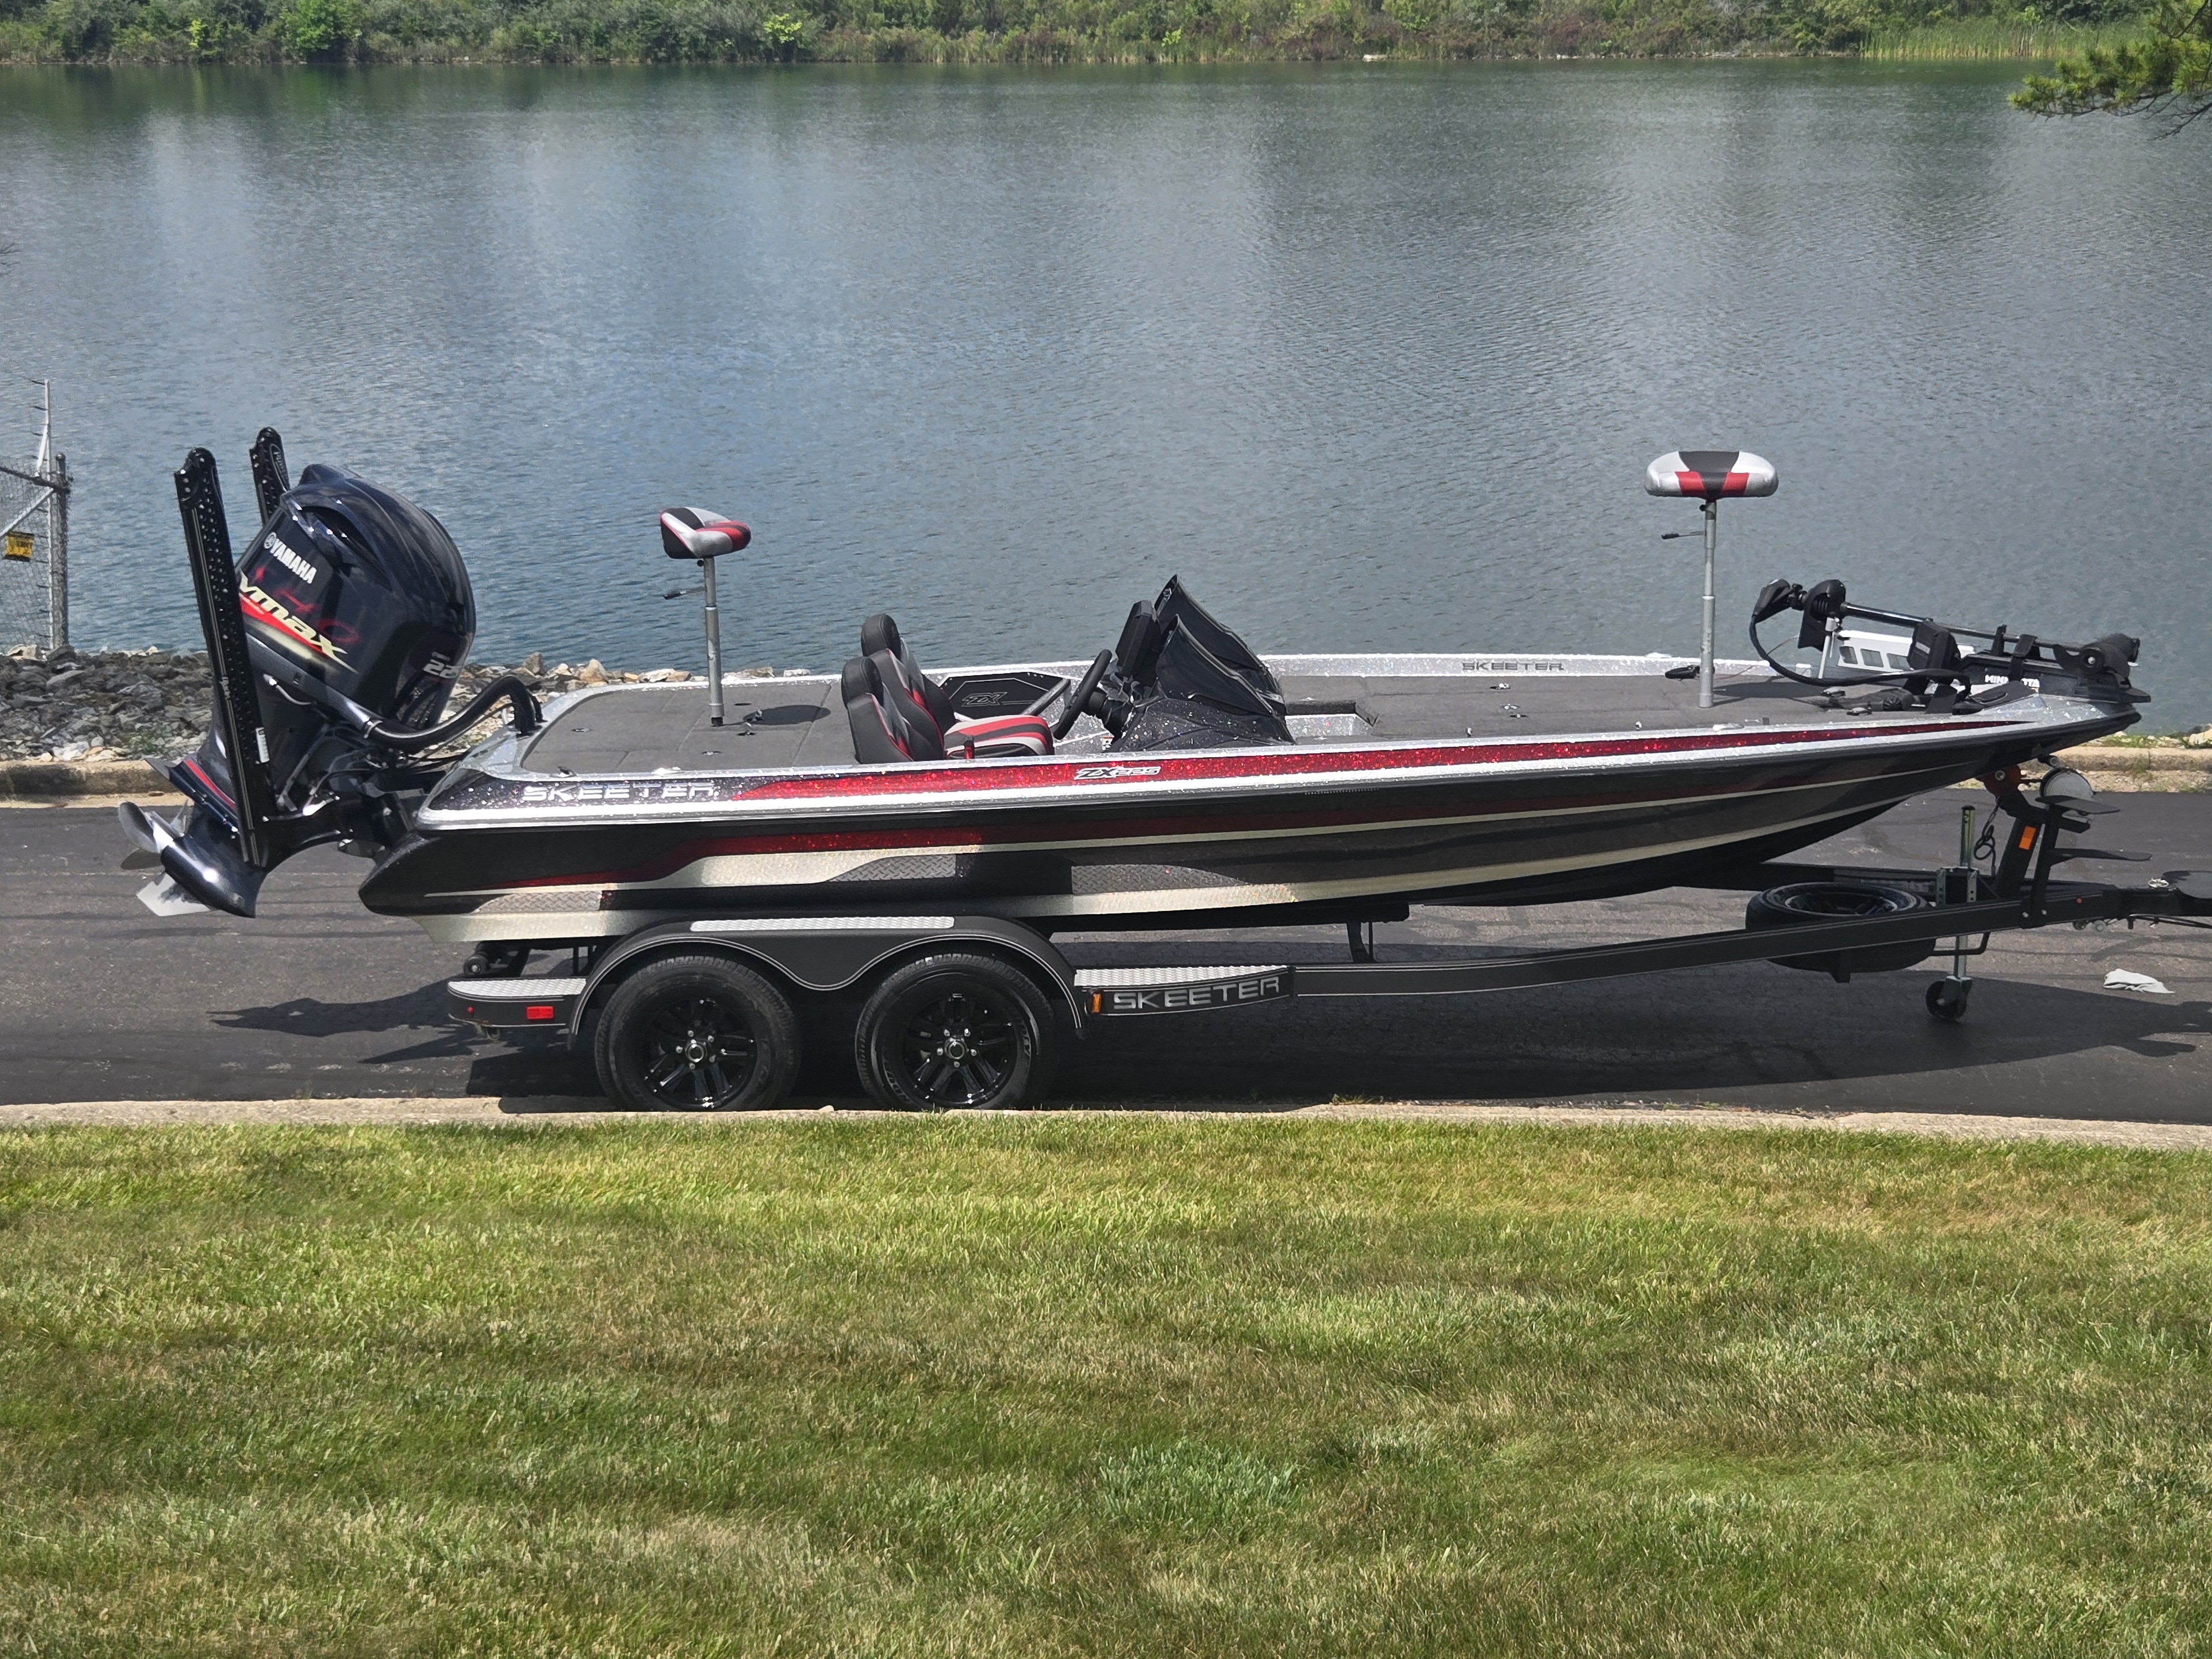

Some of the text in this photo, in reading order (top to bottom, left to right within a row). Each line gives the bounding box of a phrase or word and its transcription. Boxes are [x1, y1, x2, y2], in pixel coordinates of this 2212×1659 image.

[270, 538, 317, 584] YAMAHA
[1462, 661, 1564, 671] SKEETER
[962, 692, 1006, 707] ZX
[521, 782, 716, 802] SKEETER
[1113, 977, 1279, 1010] SKEETER
